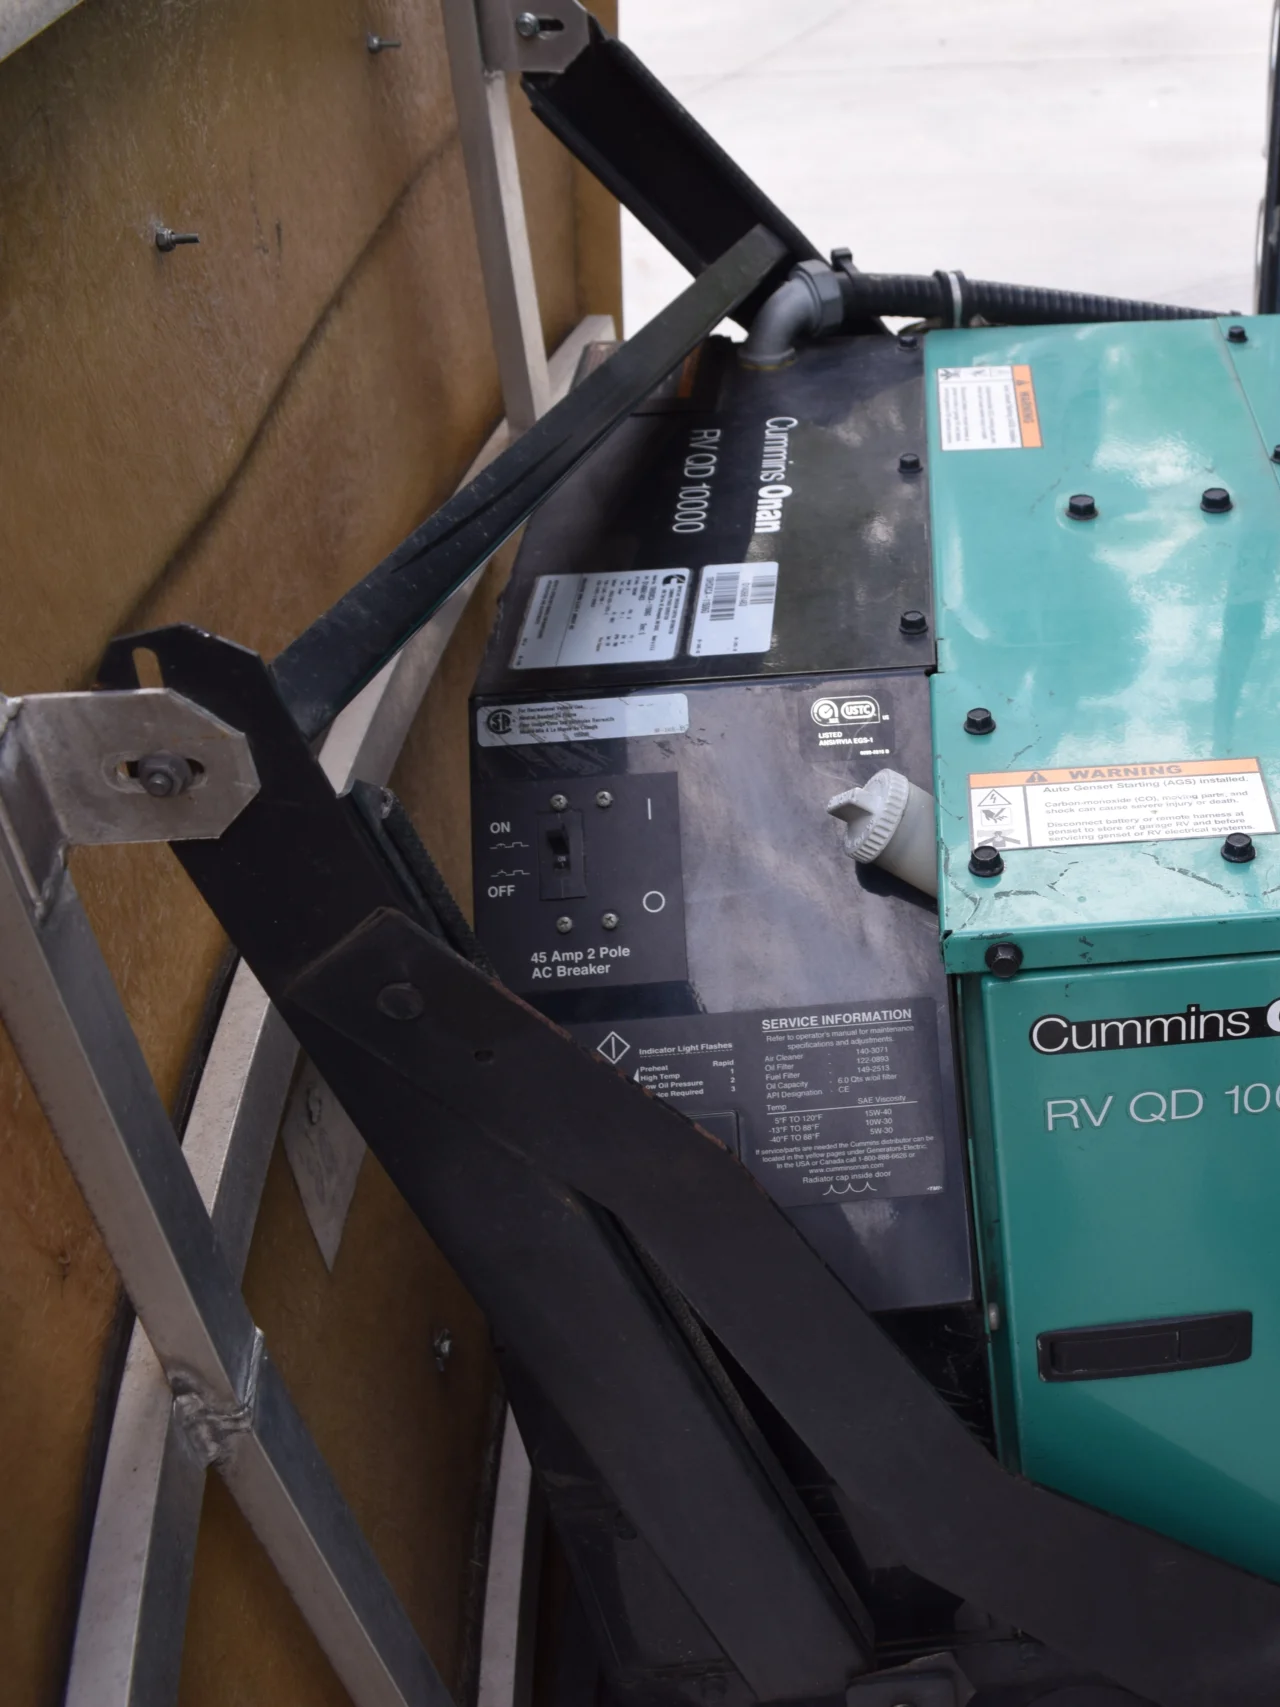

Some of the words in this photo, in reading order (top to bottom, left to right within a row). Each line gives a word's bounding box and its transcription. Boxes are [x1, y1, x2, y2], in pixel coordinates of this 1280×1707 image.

[689, 429, 721, 450] RV
[760, 416, 799, 482] Cummins
[684, 453, 717, 478] QD
[672, 482, 711, 533] 10000
[754, 484, 793, 533] Onan
[845, 705, 871, 715] USTC
[818, 731, 843, 739] LISTED
[1068, 764, 1183, 781] WARNING
[1043, 785, 1070, 794] Auto
[1073, 783, 1113, 792] Genset
[1117, 779, 1160, 791] Starting
[1163, 778, 1197, 788] (AGS)
[1199, 775, 1249, 785] installed.
[1162, 794, 1198, 802] moving
[1045, 807, 1075, 815] shock
[489, 822, 511, 834] ON
[1047, 819, 1103, 828] Disconnect
[1106, 817, 1140, 825] battery
[1156, 814, 1190, 822] remote
[1048, 828, 1082, 836] genset
[1139, 822, 1172, 830] garage
[1048, 834, 1094, 843] servicing
[1097, 832, 1131, 840] genset
[1164, 827, 1209, 835] electrical
[1212, 824, 1256, 833] systems.
[487, 885, 516, 898] OFF
[531, 952, 547, 964] 45
[551, 950, 584, 963] Amp
[587, 948, 596, 959] 2
[599, 946, 631, 958] Pole
[531, 967, 552, 979] AC
[556, 963, 611, 977] Breaker
[762, 1015, 819, 1030] SERVICE
[822, 1008, 912, 1025] INFORMATION
[795, 1031, 830, 1041] operator's
[831, 1029, 858, 1037] manual
[870, 1025, 915, 1034] maintenance
[1032, 1006, 1250, 1052] Cummins
[639, 1046, 676, 1055] Indicator
[677, 1044, 699, 1054] Light
[700, 1042, 733, 1051] Flashes
[787, 1040, 834, 1051] specifications
[764, 1055, 774, 1063] Air
[776, 1053, 804, 1062] Cleaner
[856, 1046, 888, 1055] 140-3071
[640, 1065, 668, 1073] Preheat
[712, 1059, 734, 1068] Rapid
[765, 1064, 775, 1072] Oil
[776, 1063, 794, 1071] Filter
[856, 1055, 890, 1065] 122-0893
[640, 1074, 658, 1083] High
[660, 1072, 680, 1081] Temp
[765, 1073, 782, 1081] Fuel
[784, 1071, 801, 1079] Filter
[857, 1065, 890, 1074] 149-2513
[670, 1079, 704, 1088] Pressure
[778, 1080, 808, 1091] Capacity
[850, 1075, 864, 1083] Qts
[864, 1074, 881, 1082] w/oil
[670, 1088, 704, 1097] Required
[781, 1088, 823, 1099] Designation
[766, 1103, 787, 1112] Temp
[857, 1097, 874, 1105] SAE
[875, 1094, 907, 1104] Viscosity
[1047, 1096, 1114, 1131] RV
[1129, 1089, 1205, 1123] QD
[802, 1114, 823, 1122] 120°F
[865, 1109, 892, 1117] 15W-40
[865, 1118, 893, 1126] 10W-30
[791, 1134, 802, 1142] TO
[870, 1127, 894, 1135] 5W-30
[761, 1146, 801, 1155] service/parts
[813, 1143, 838, 1151] needed
[850, 1139, 880, 1148] Cummins
[881, 1137, 912, 1145] distributor
[762, 1155, 786, 1163] located
[805, 1152, 825, 1160] yellow
[795, 1160, 810, 1168] USA
[819, 1157, 845, 1165] Canada
[808, 1162, 885, 1174] www.cumminsonan.com
[802, 1175, 834, 1184] Radiator
[835, 1174, 850, 1182] cap
[851, 1171, 873, 1180] inside
[874, 1170, 891, 1178] door
